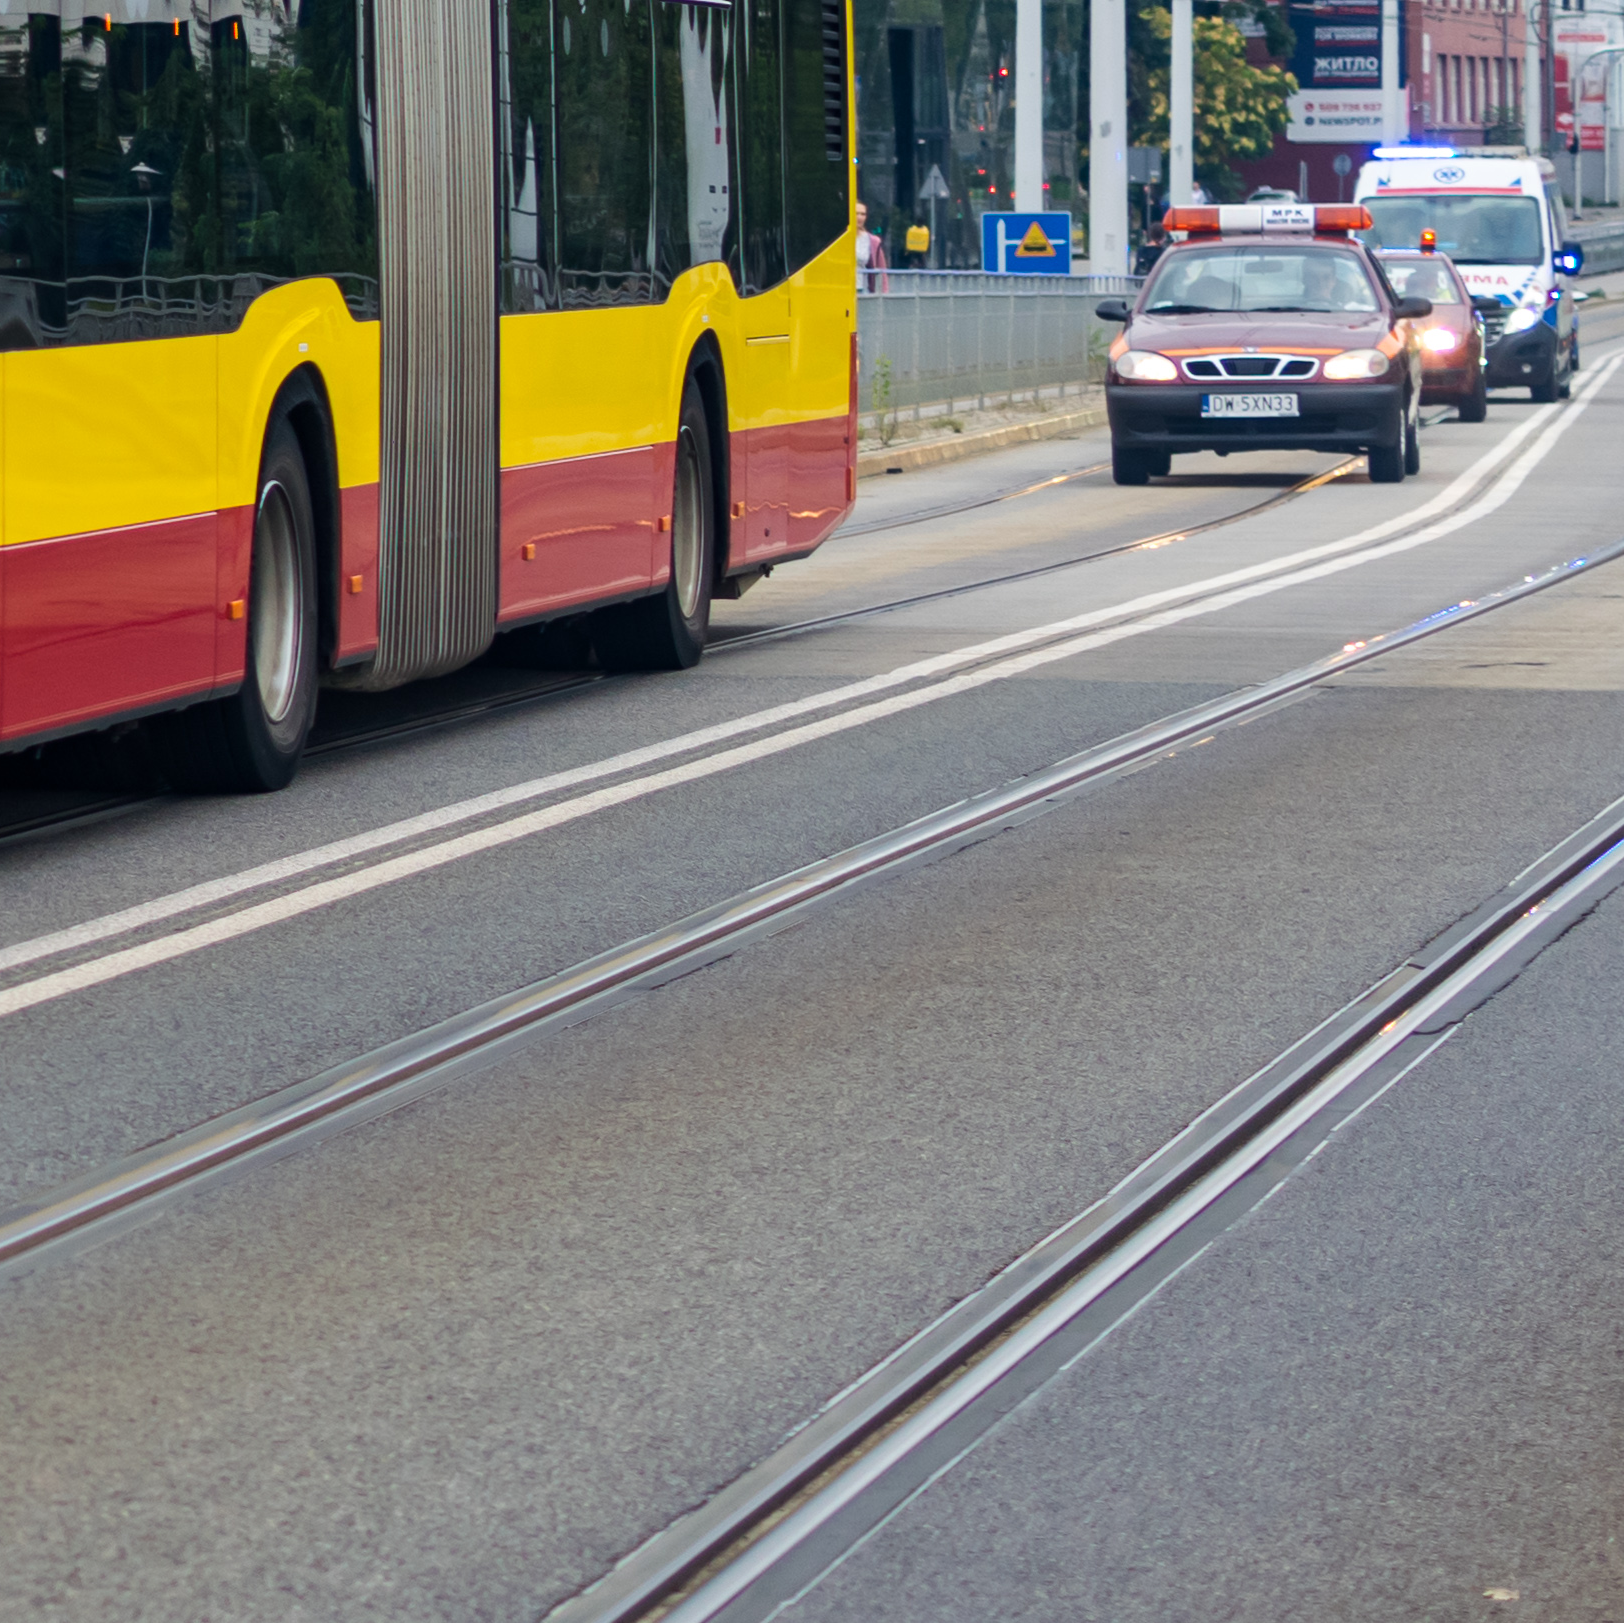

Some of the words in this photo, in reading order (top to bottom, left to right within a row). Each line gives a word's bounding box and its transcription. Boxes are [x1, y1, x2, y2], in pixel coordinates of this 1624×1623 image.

[1314, 56, 1379, 71] ЖИТЛО
[1212, 396, 1234, 412] DW
[1241, 396, 1293, 412] 5XN33
